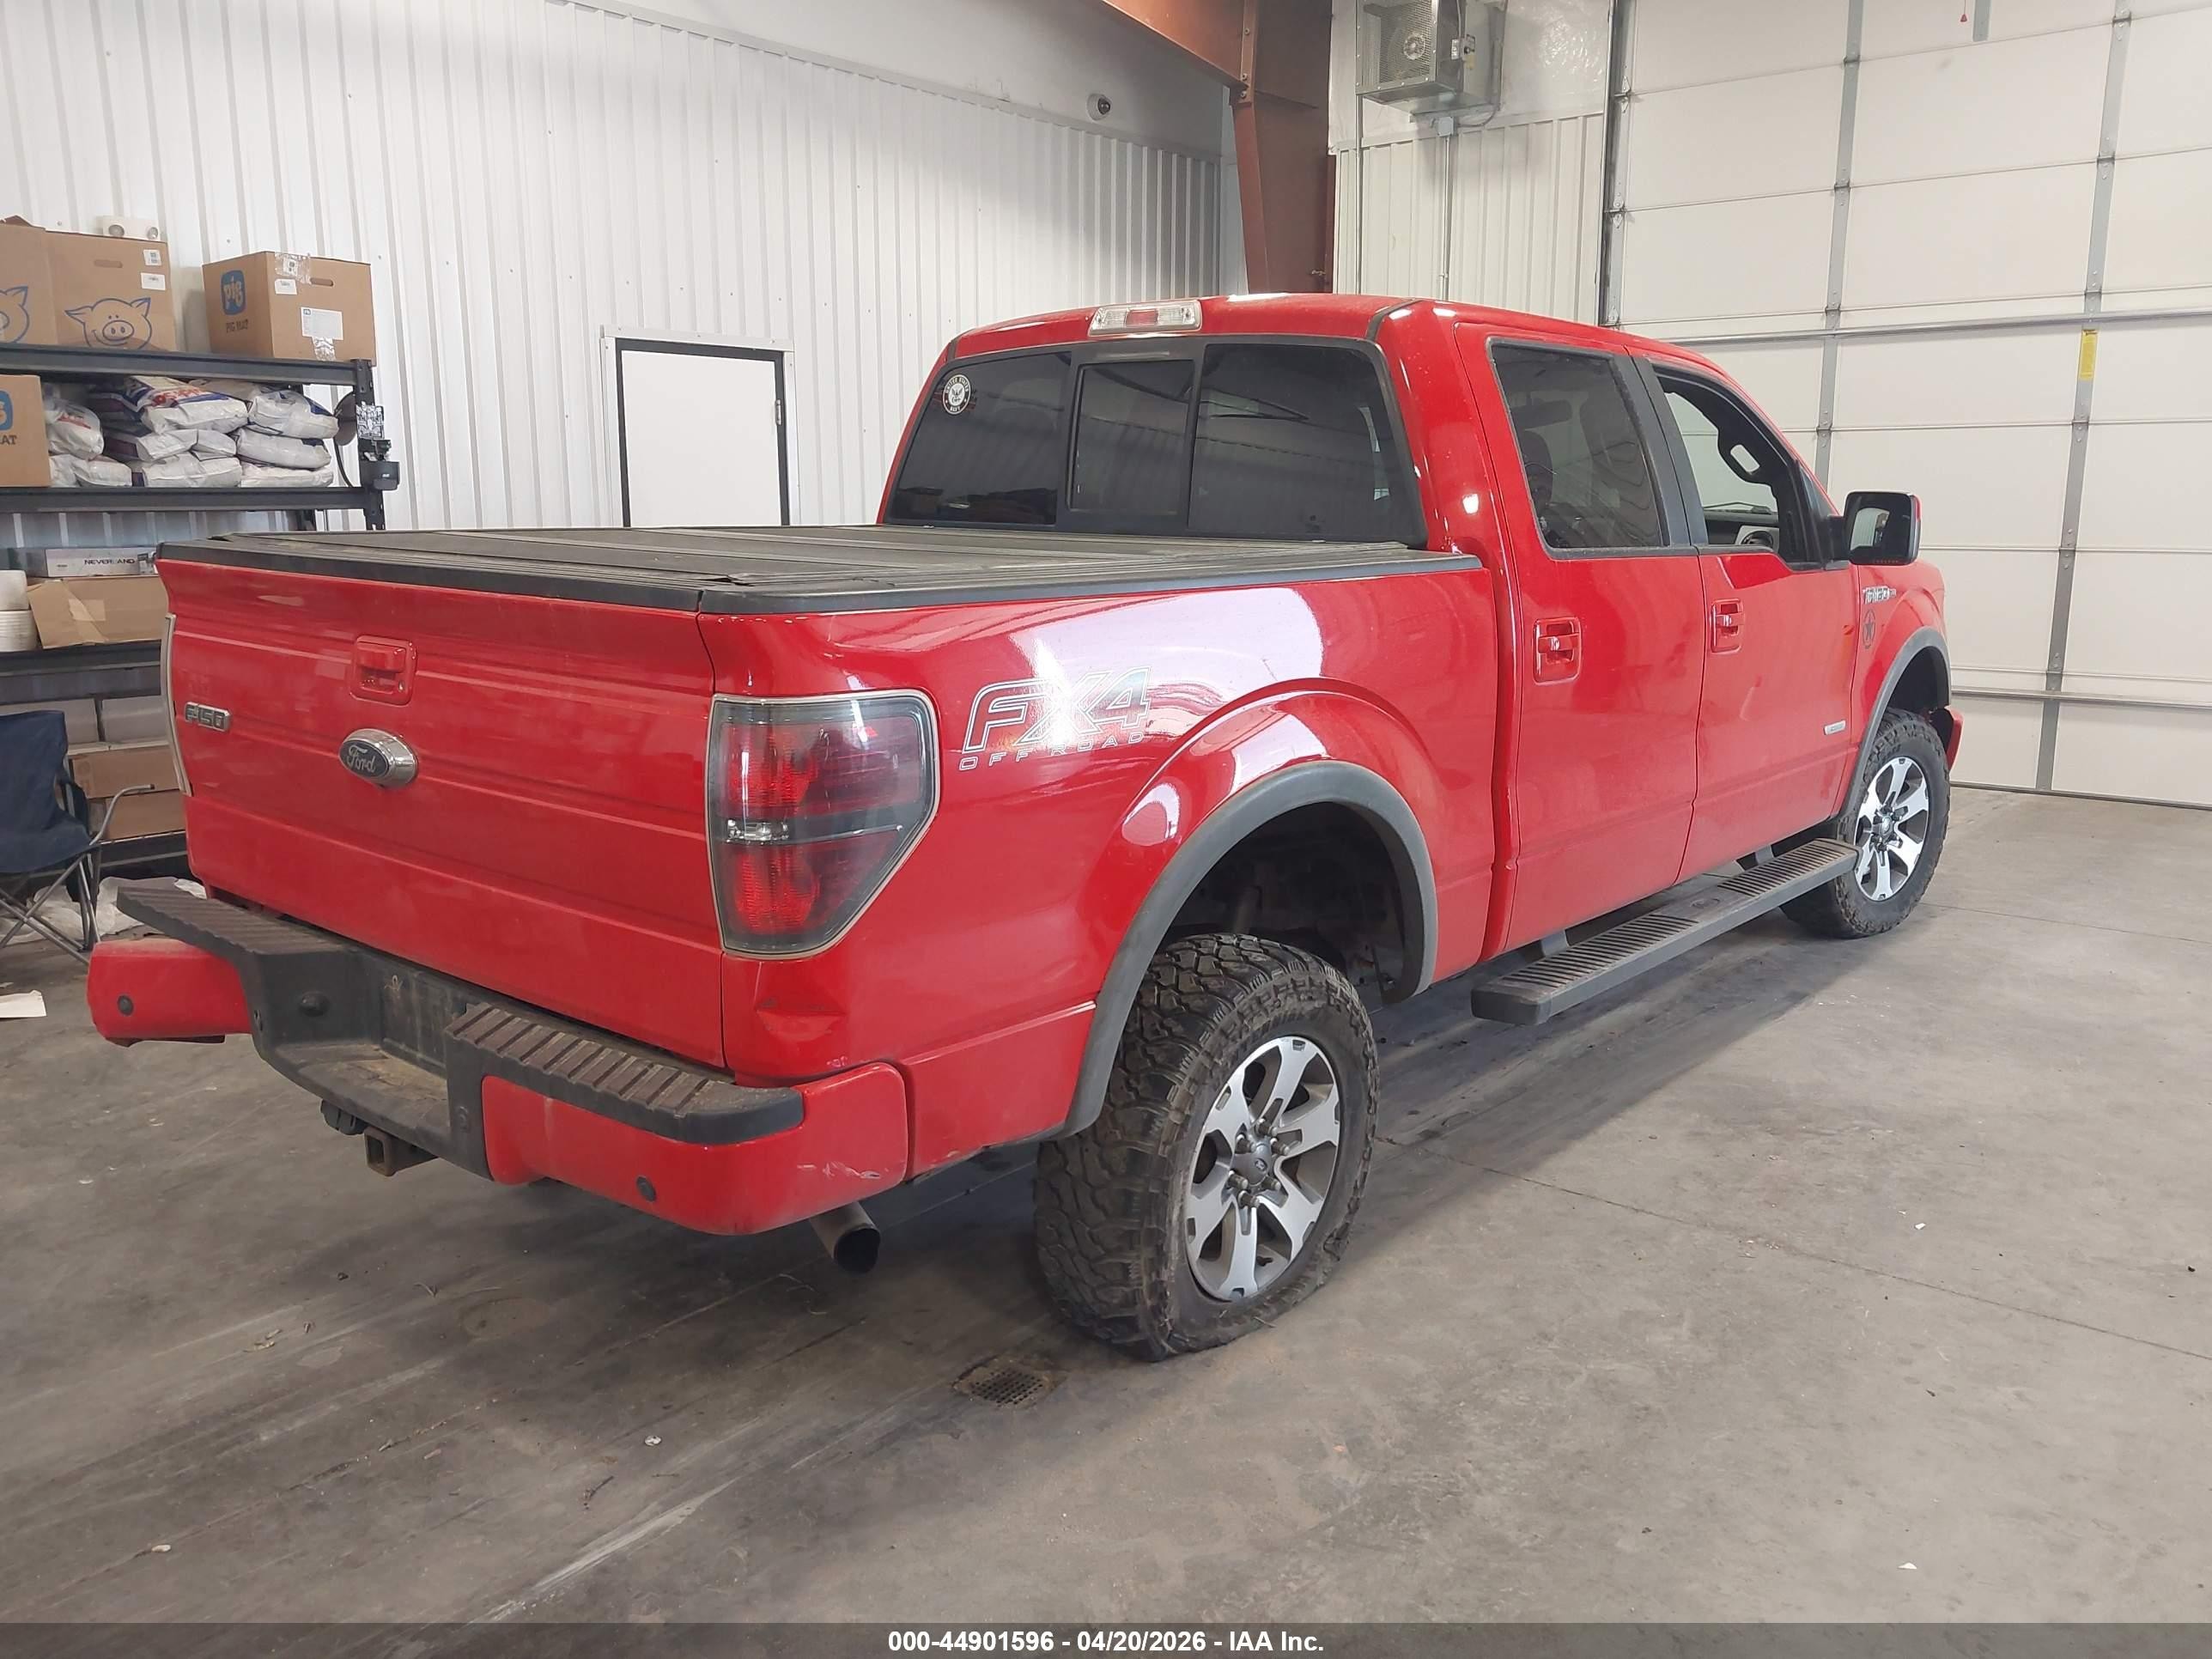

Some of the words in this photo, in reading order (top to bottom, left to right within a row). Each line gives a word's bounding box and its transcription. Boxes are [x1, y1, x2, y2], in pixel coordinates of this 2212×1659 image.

[961, 666, 1152, 755] FX4
[347, 744, 376, 773] Ford
[959, 746, 1033, 770] OFF
[1050, 731, 1146, 757] ROAD
